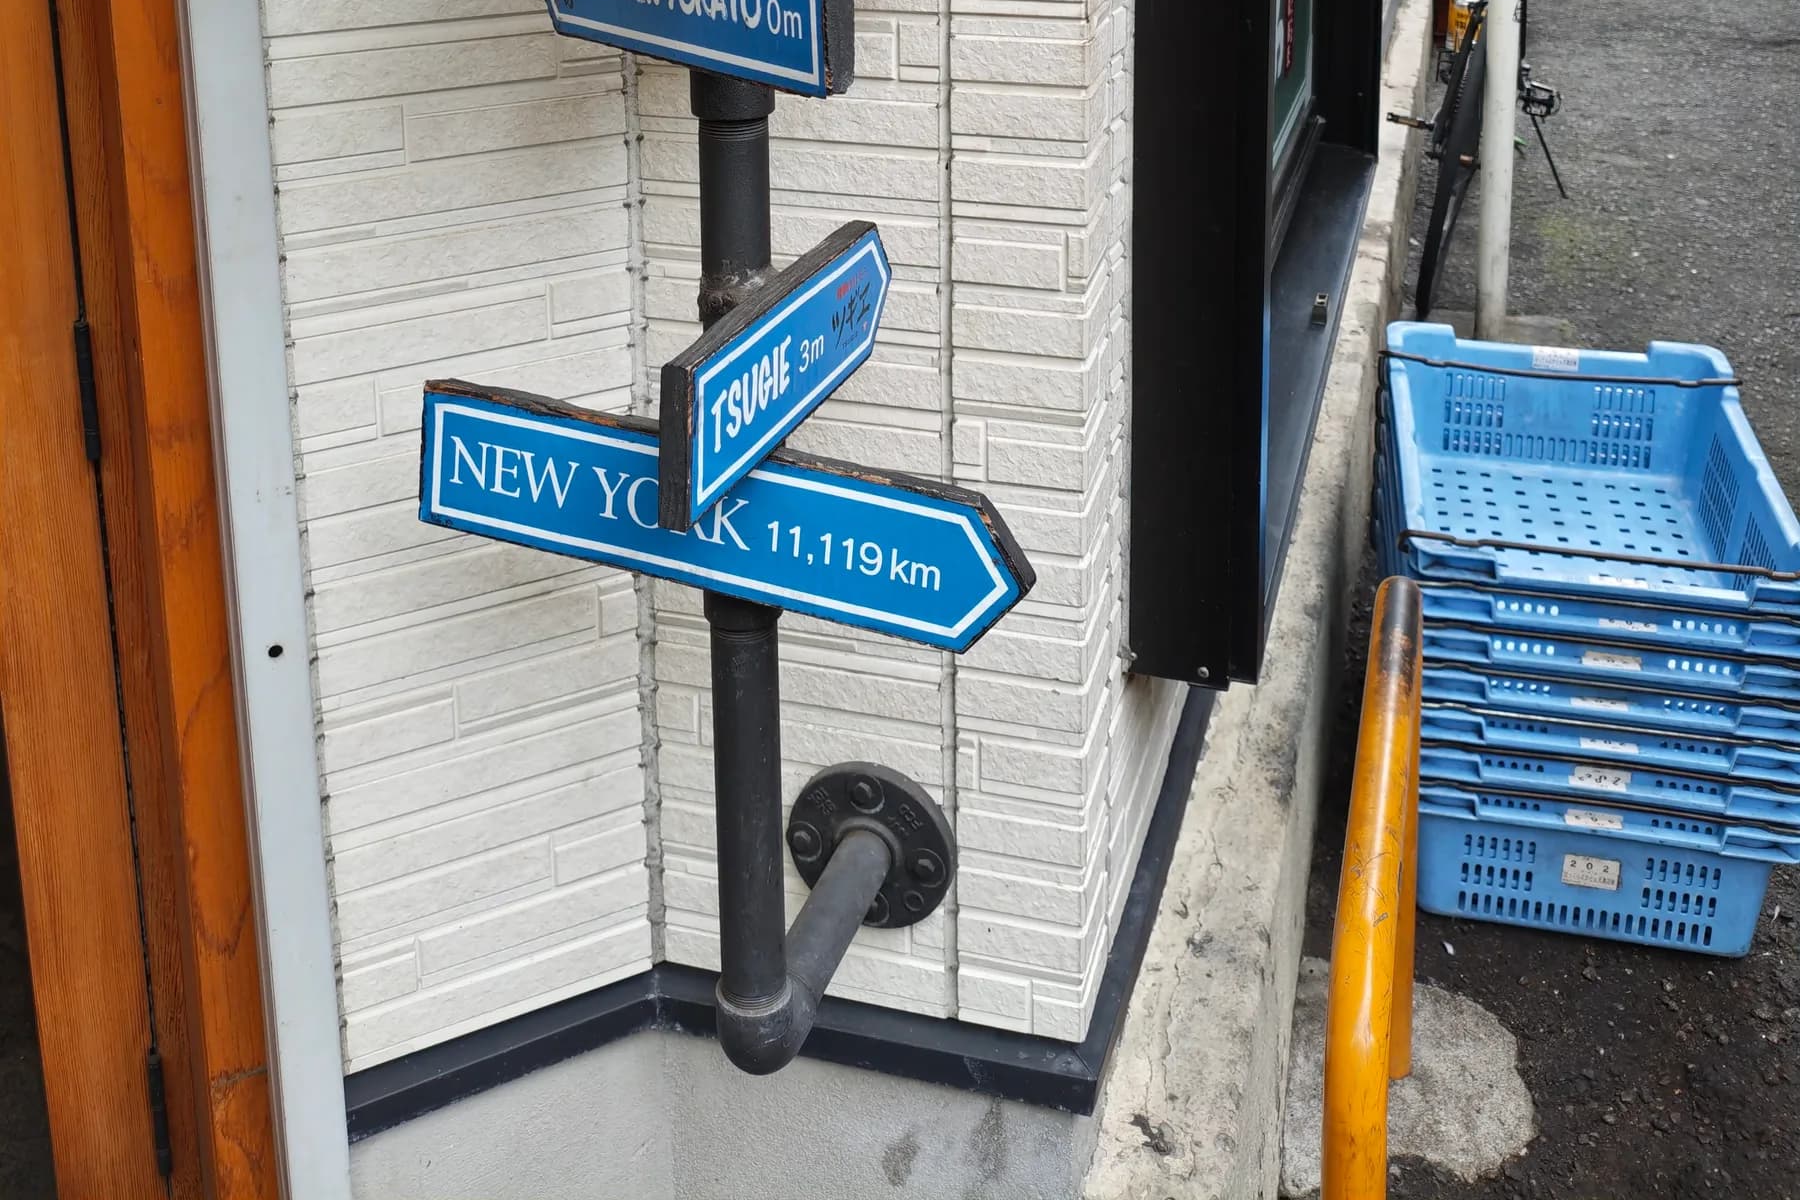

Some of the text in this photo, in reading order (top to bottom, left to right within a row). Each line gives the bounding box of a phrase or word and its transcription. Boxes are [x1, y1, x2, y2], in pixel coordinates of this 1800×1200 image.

[711, 335, 824, 455] TSUGIE 3m
[449, 435, 580, 509] NEW
[592, 465, 751, 552] YOK
